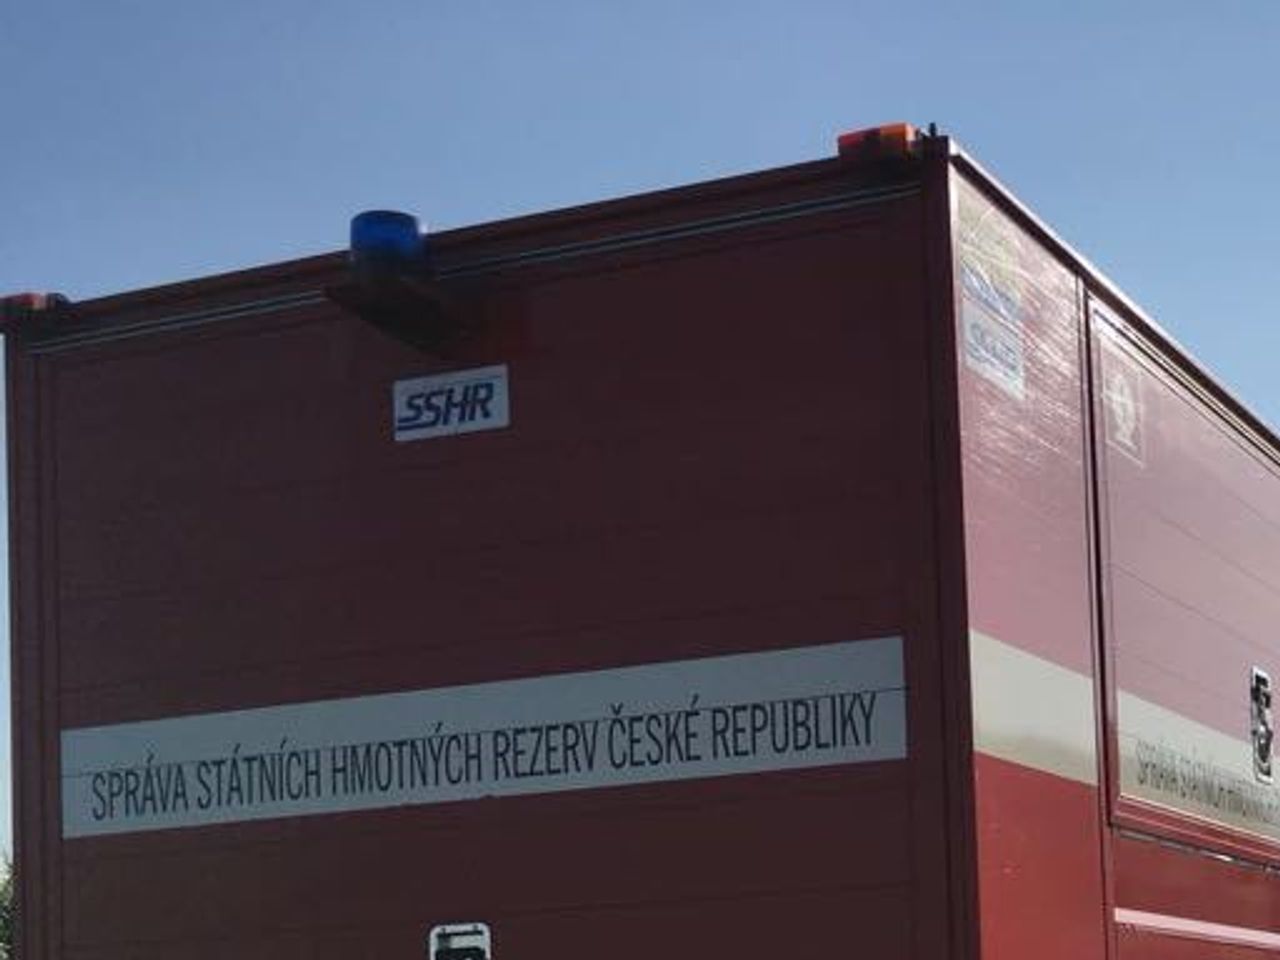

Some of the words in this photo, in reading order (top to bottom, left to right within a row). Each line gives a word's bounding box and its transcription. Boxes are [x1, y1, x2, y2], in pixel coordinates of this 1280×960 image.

[397, 383, 494, 431] SSHR
[92, 753, 189, 821] SPRÁVA
[197, 737, 322, 810] STÁTNÍCH
[331, 722, 482, 795] HMOTNÝCH
[494, 720, 600, 782] REZERV
[608, 694, 702, 769] ČESKÉ
[712, 690, 878, 760] REPUBLIKY
